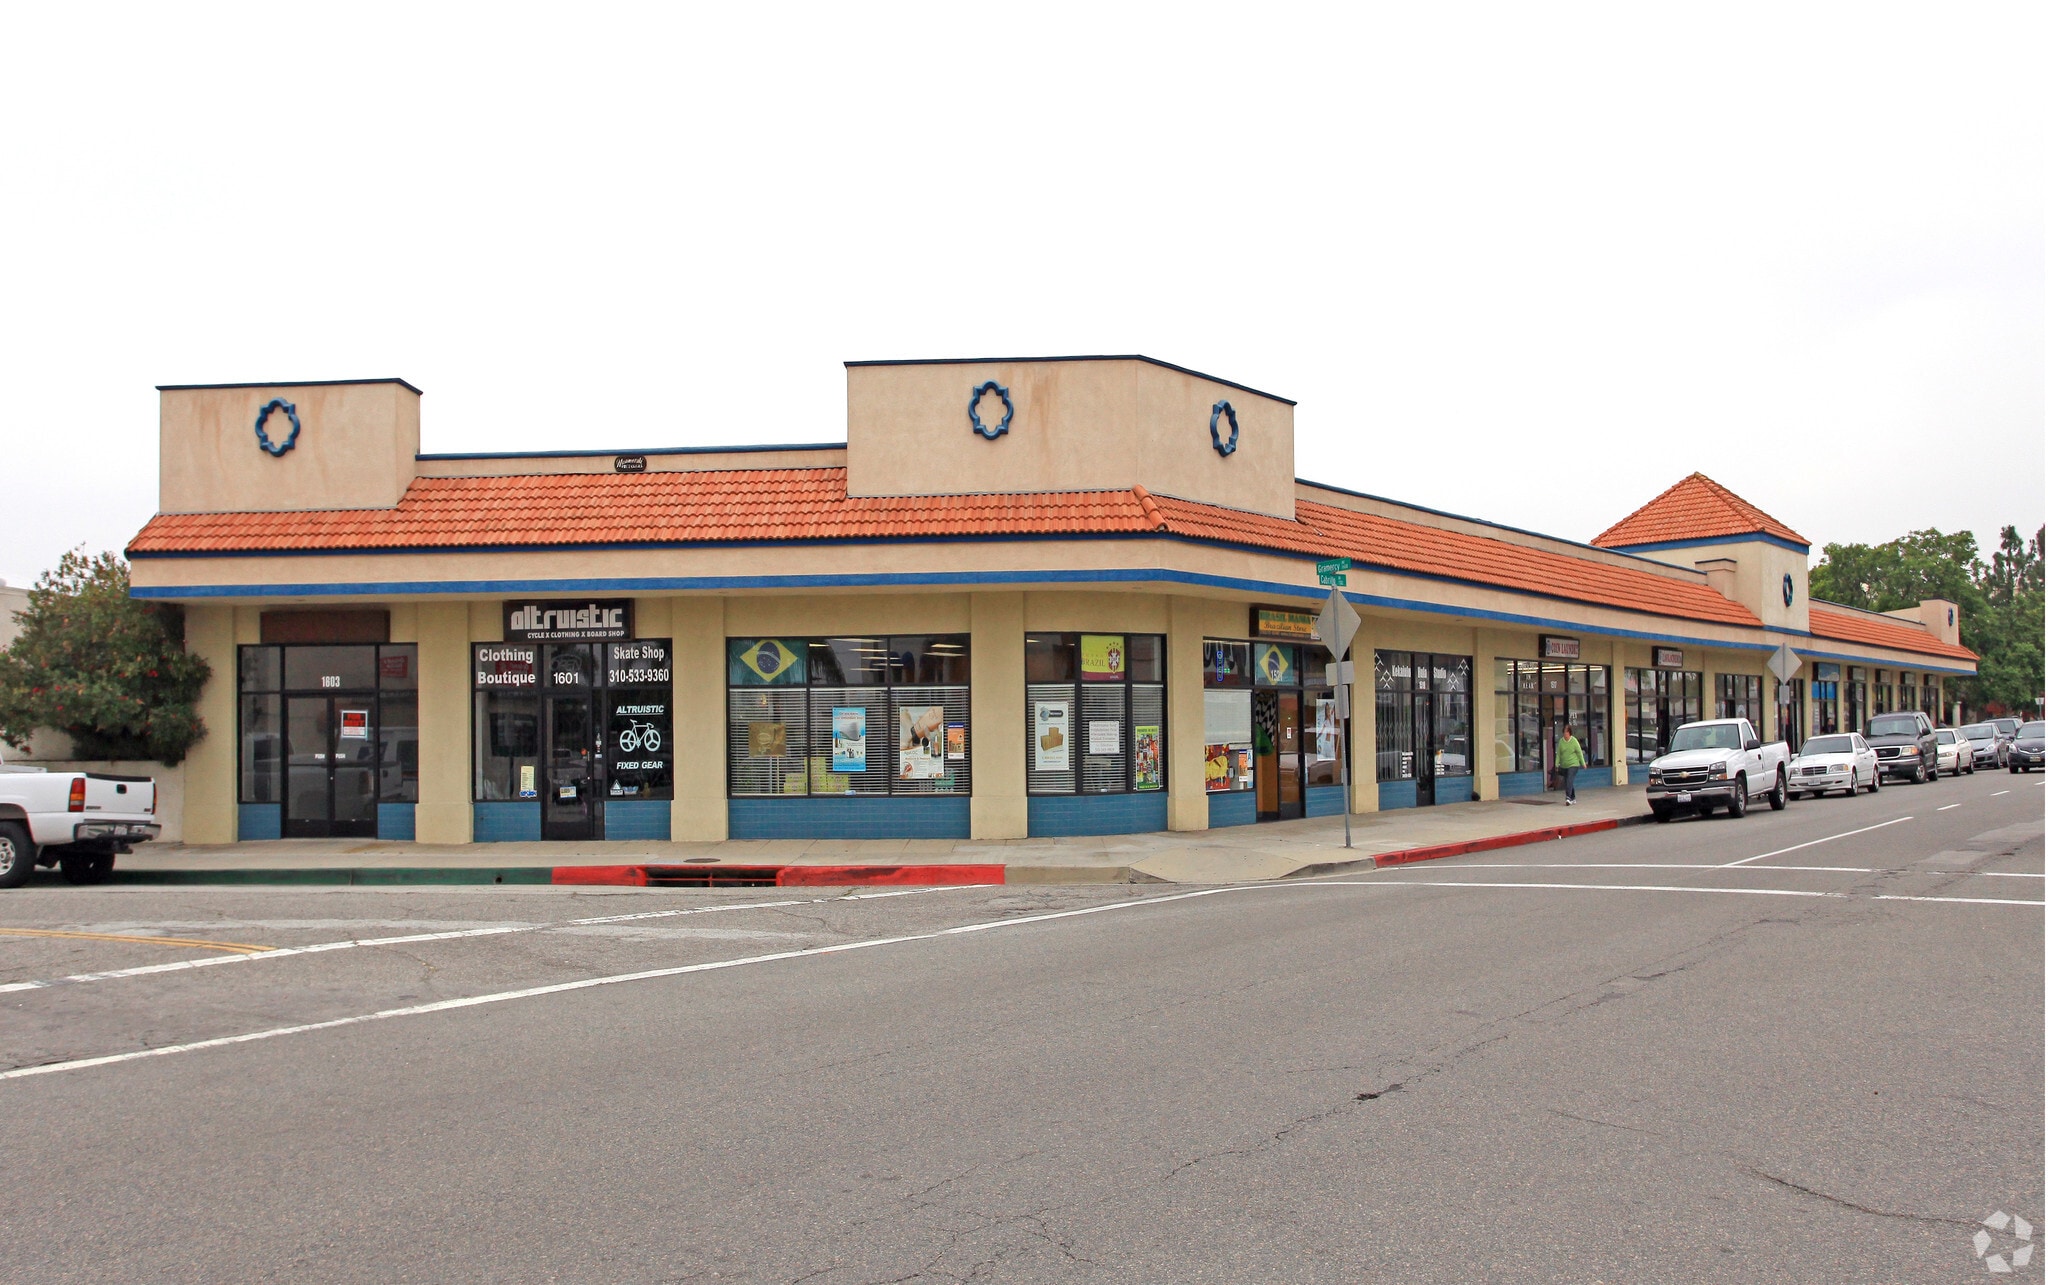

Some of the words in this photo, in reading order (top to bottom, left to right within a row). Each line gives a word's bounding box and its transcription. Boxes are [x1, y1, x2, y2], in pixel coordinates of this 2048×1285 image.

[1317, 563, 1340, 574] Gramercy
[479, 648, 534, 663] Clothing
[613, 647, 640, 660] Skate
[642, 645, 665, 661] Shop
[321, 675, 340, 688] 1603
[477, 671, 536, 687] Boutique
[553, 672, 579, 685] 1601
[609, 668, 670, 683] 310-533-9360
[616, 705, 665, 714] ALTRUISTIC
[616, 761, 639, 770] FIXED
[641, 761, 663, 769] GEAR
